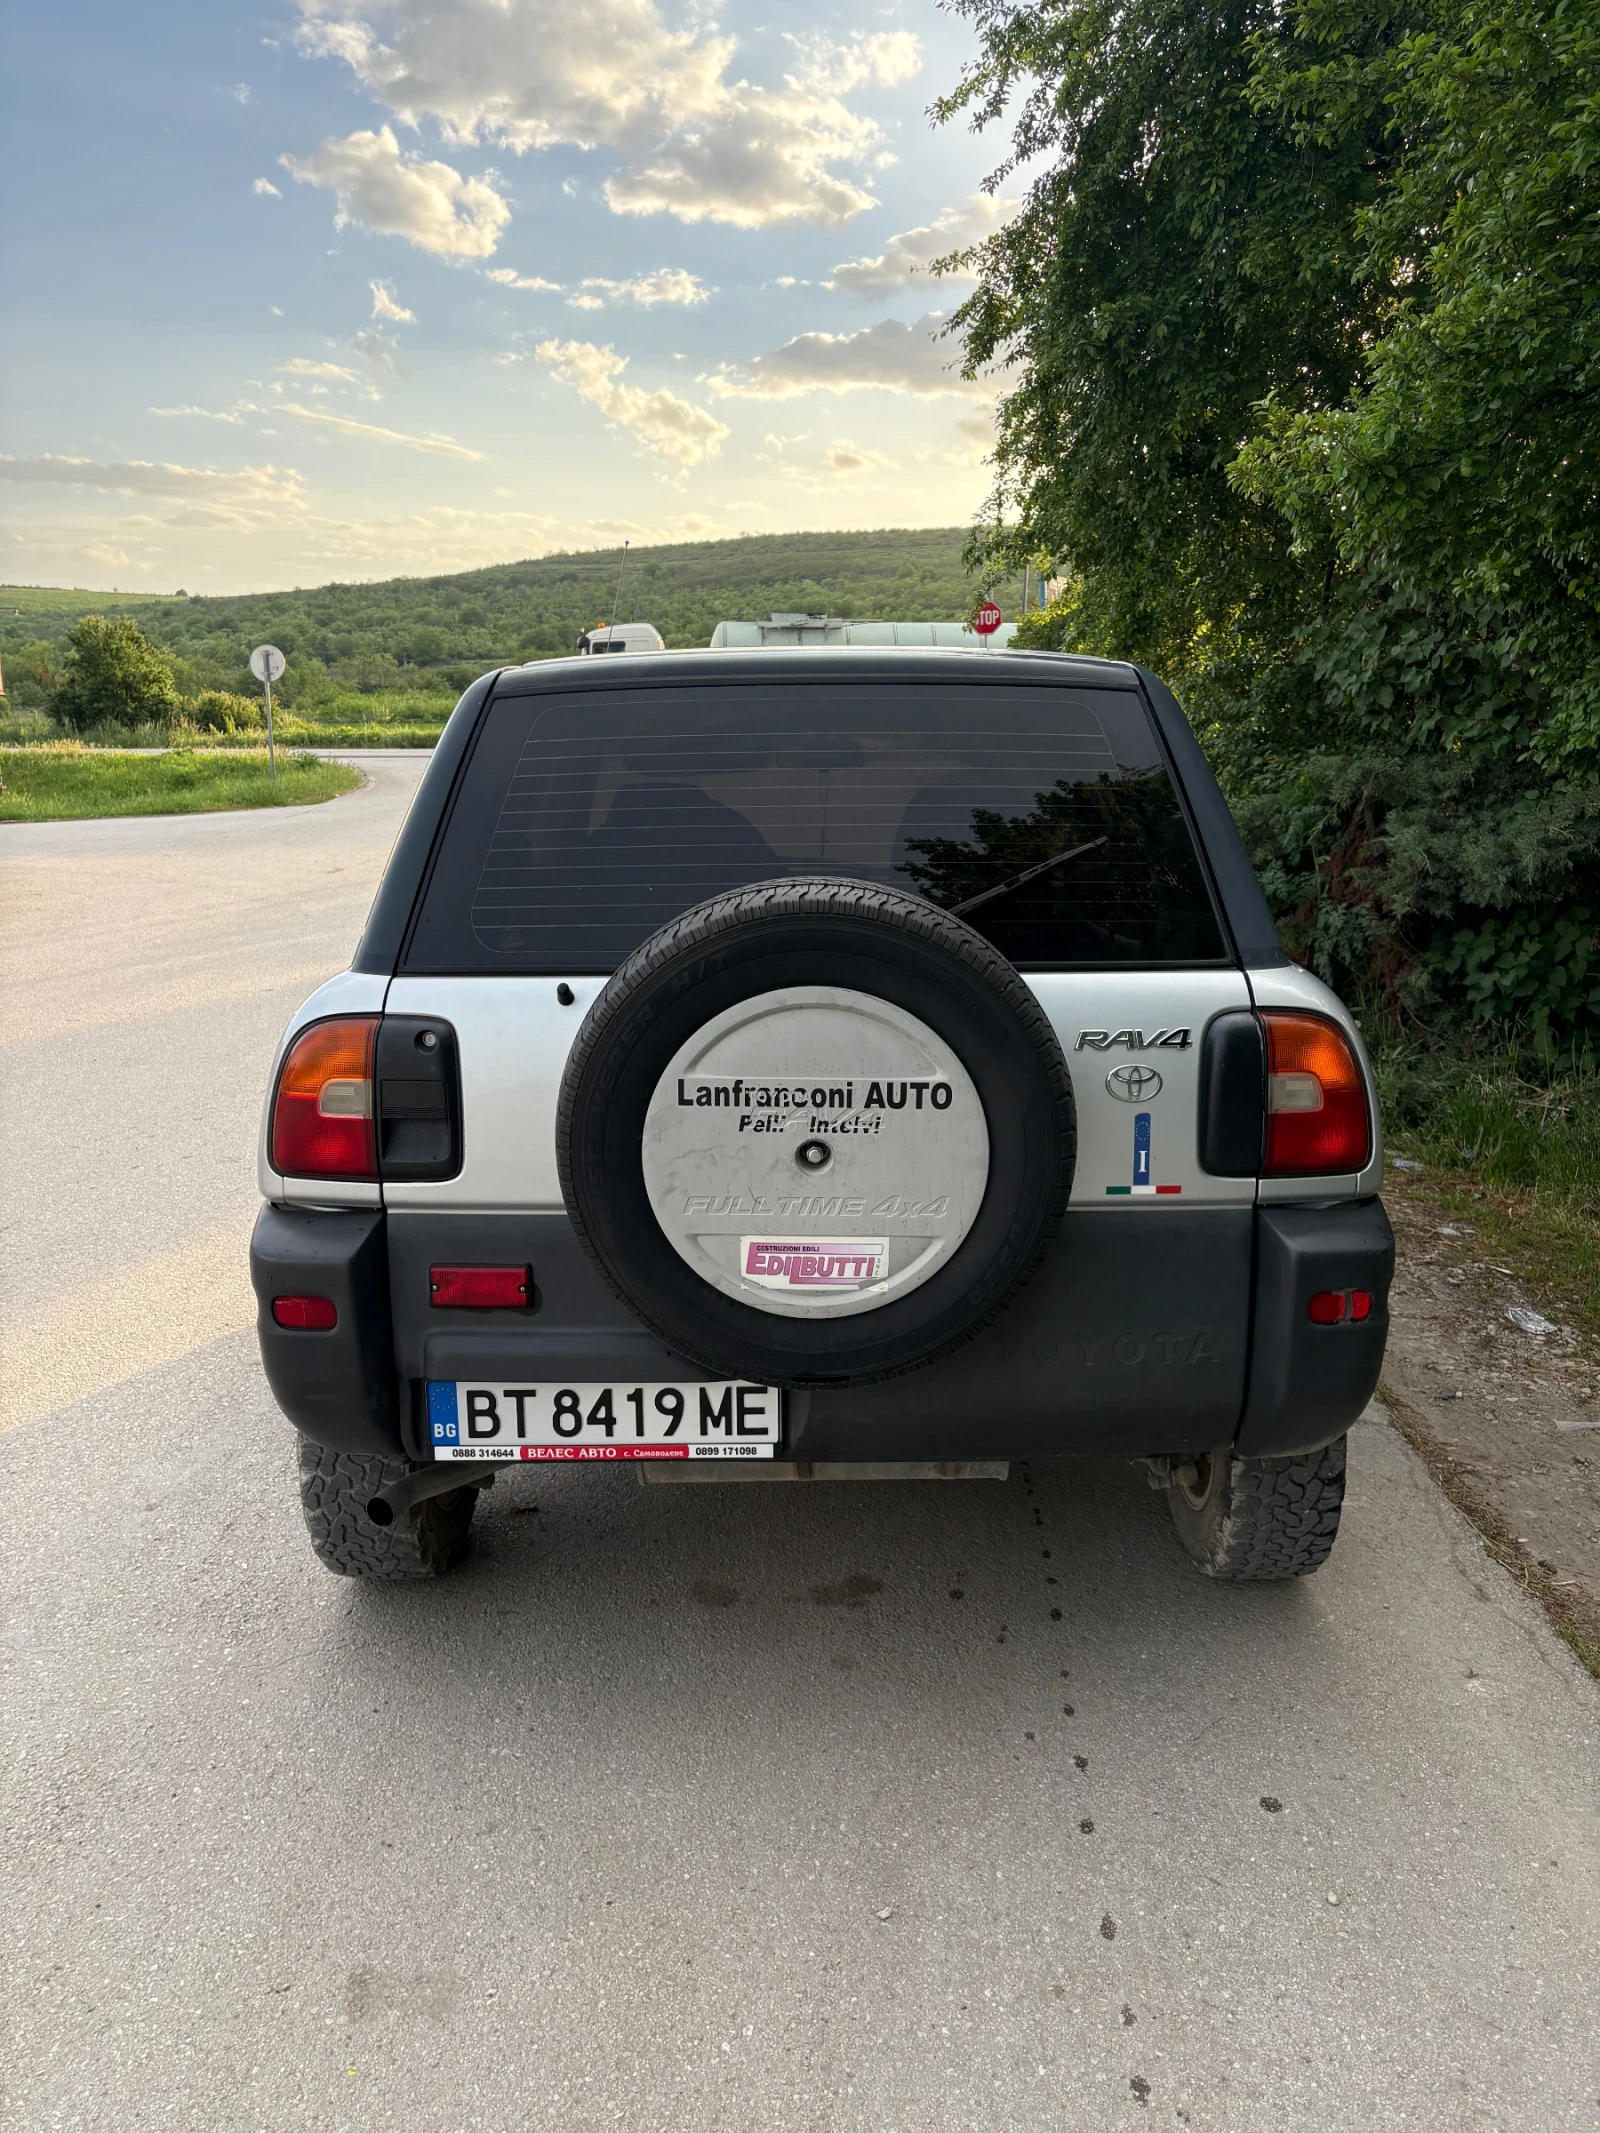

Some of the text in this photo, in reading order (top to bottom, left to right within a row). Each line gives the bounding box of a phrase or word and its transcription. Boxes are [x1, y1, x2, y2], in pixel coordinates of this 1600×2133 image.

[974, 610, 1000, 626] TOP
[1074, 1026, 1192, 1051] RAV4
[677, 1079, 953, 1110] Lanfranconi AUTO
[1138, 1150, 1148, 1173] I
[683, 1194, 950, 1218] FULL TIME 4x4
[991, 1331, 1221, 1366] TOYOTA
[466, 1386, 769, 1439] BT 8419 ME
[434, 1423, 457, 1438] BG
[452, 1448, 515, 1458] 0888 314644
[527, 1447, 574, 1459] ВЕЛЕС
[578, 1447, 617, 1458] АВТО
[695, 1446, 758, 1456] 0899 171098
